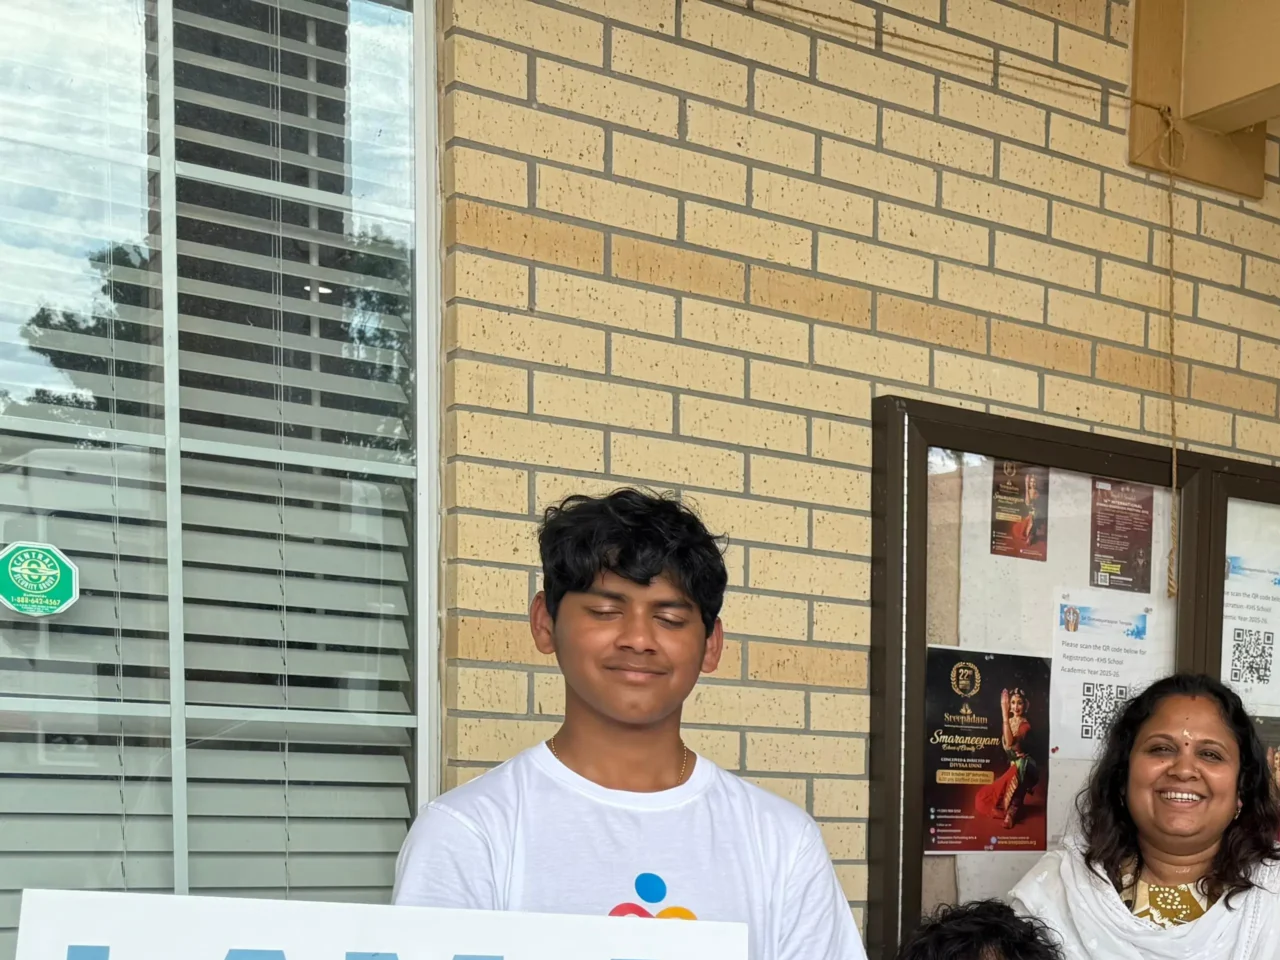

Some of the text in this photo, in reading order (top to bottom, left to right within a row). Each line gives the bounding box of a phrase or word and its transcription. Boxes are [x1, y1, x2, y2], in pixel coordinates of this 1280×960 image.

[14, 552, 54, 568] CENTRAL
[14, 573, 56, 591] SECURITY GROUP
[1062, 640, 1078, 649] Please
[1124, 647, 1138, 655] below
[1063, 653, 1094, 663] Registration
[1107, 657, 1124, 665] School
[1061, 666, 1086, 674] Academic
[1087, 667, 1099, 675] Year
[944, 712, 988, 725] Sreepadam
[930, 729, 1000, 749] Smaraneeyam
